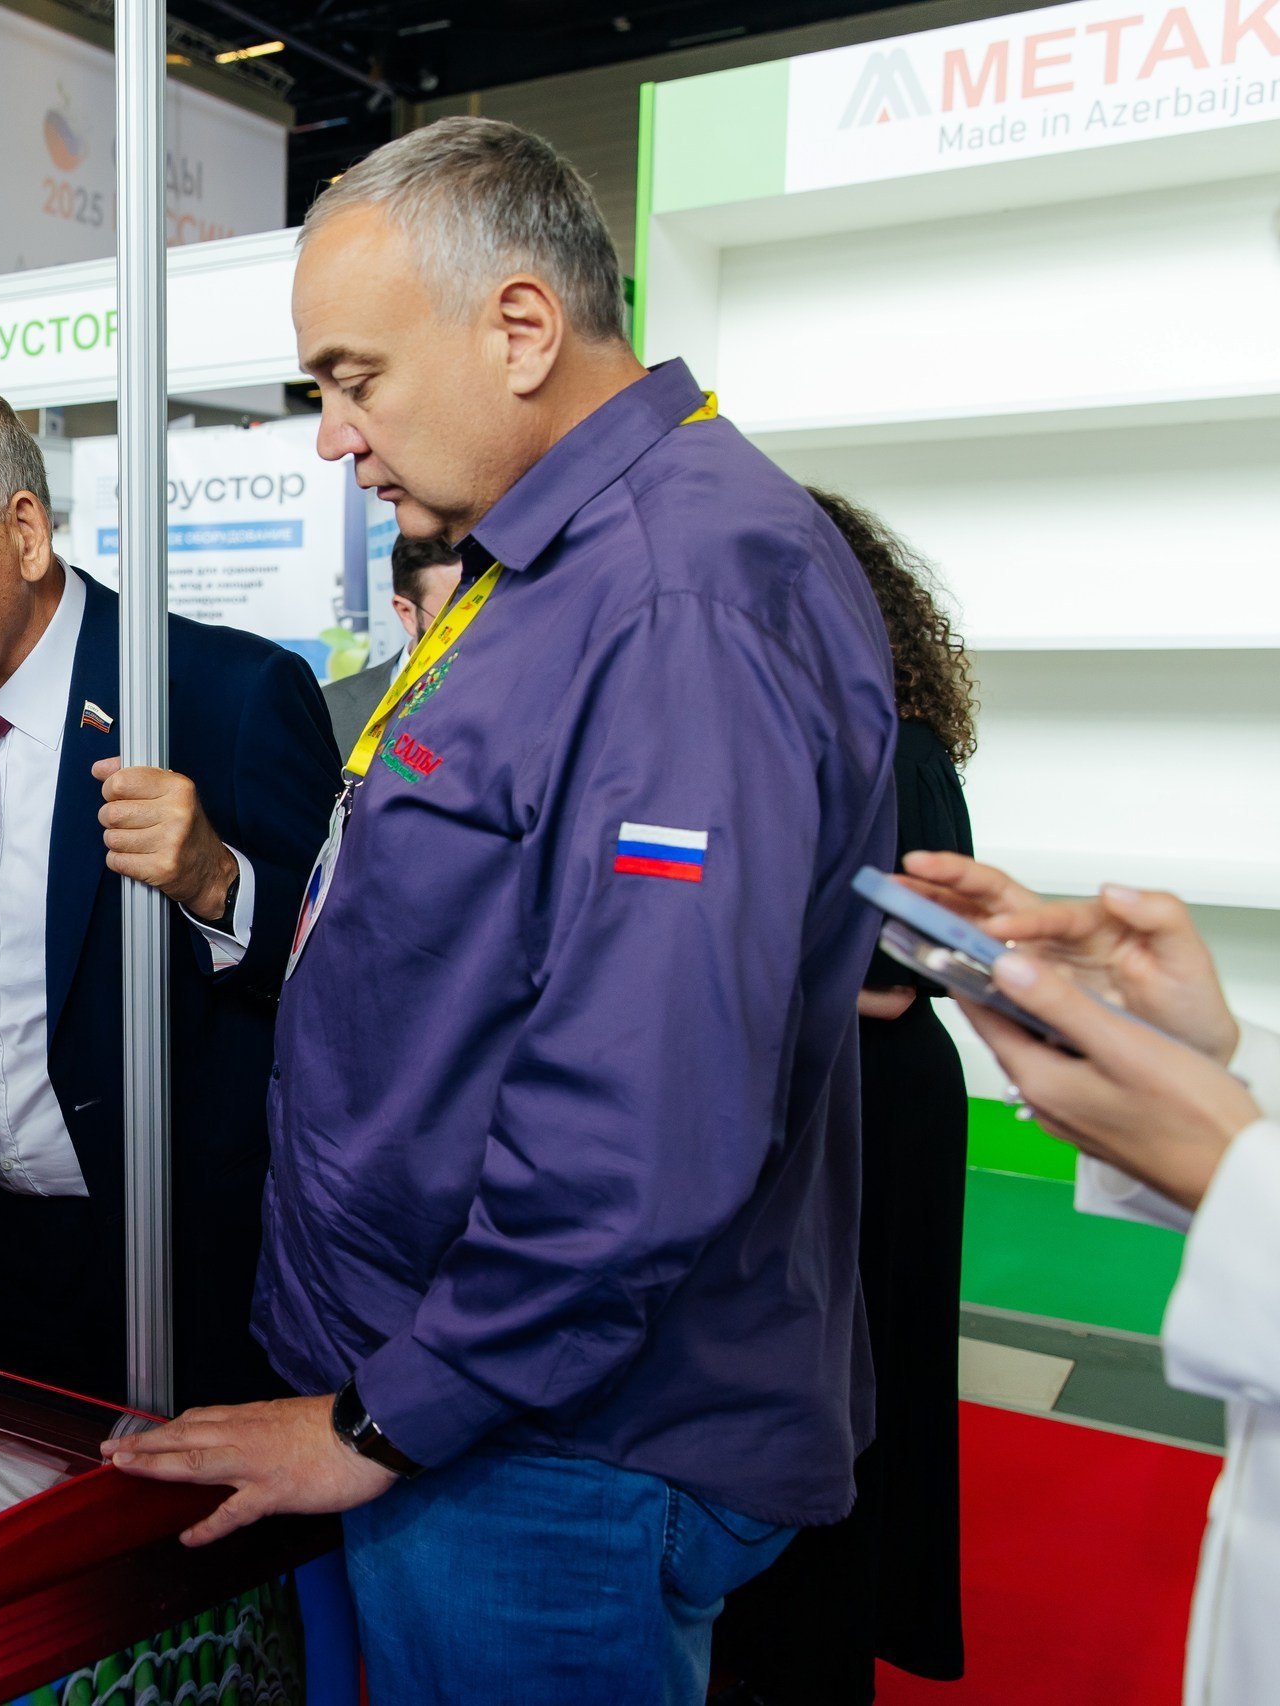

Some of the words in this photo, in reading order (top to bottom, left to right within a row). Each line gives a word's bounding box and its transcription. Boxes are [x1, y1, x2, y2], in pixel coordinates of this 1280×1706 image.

[941, 0, 1280, 113] METAK
[938, 115, 1028, 155] Made
[1040, 107, 1071, 139] in
[41, 176, 104, 228] 2025
[393, 732, 444, 776] САДЫ
